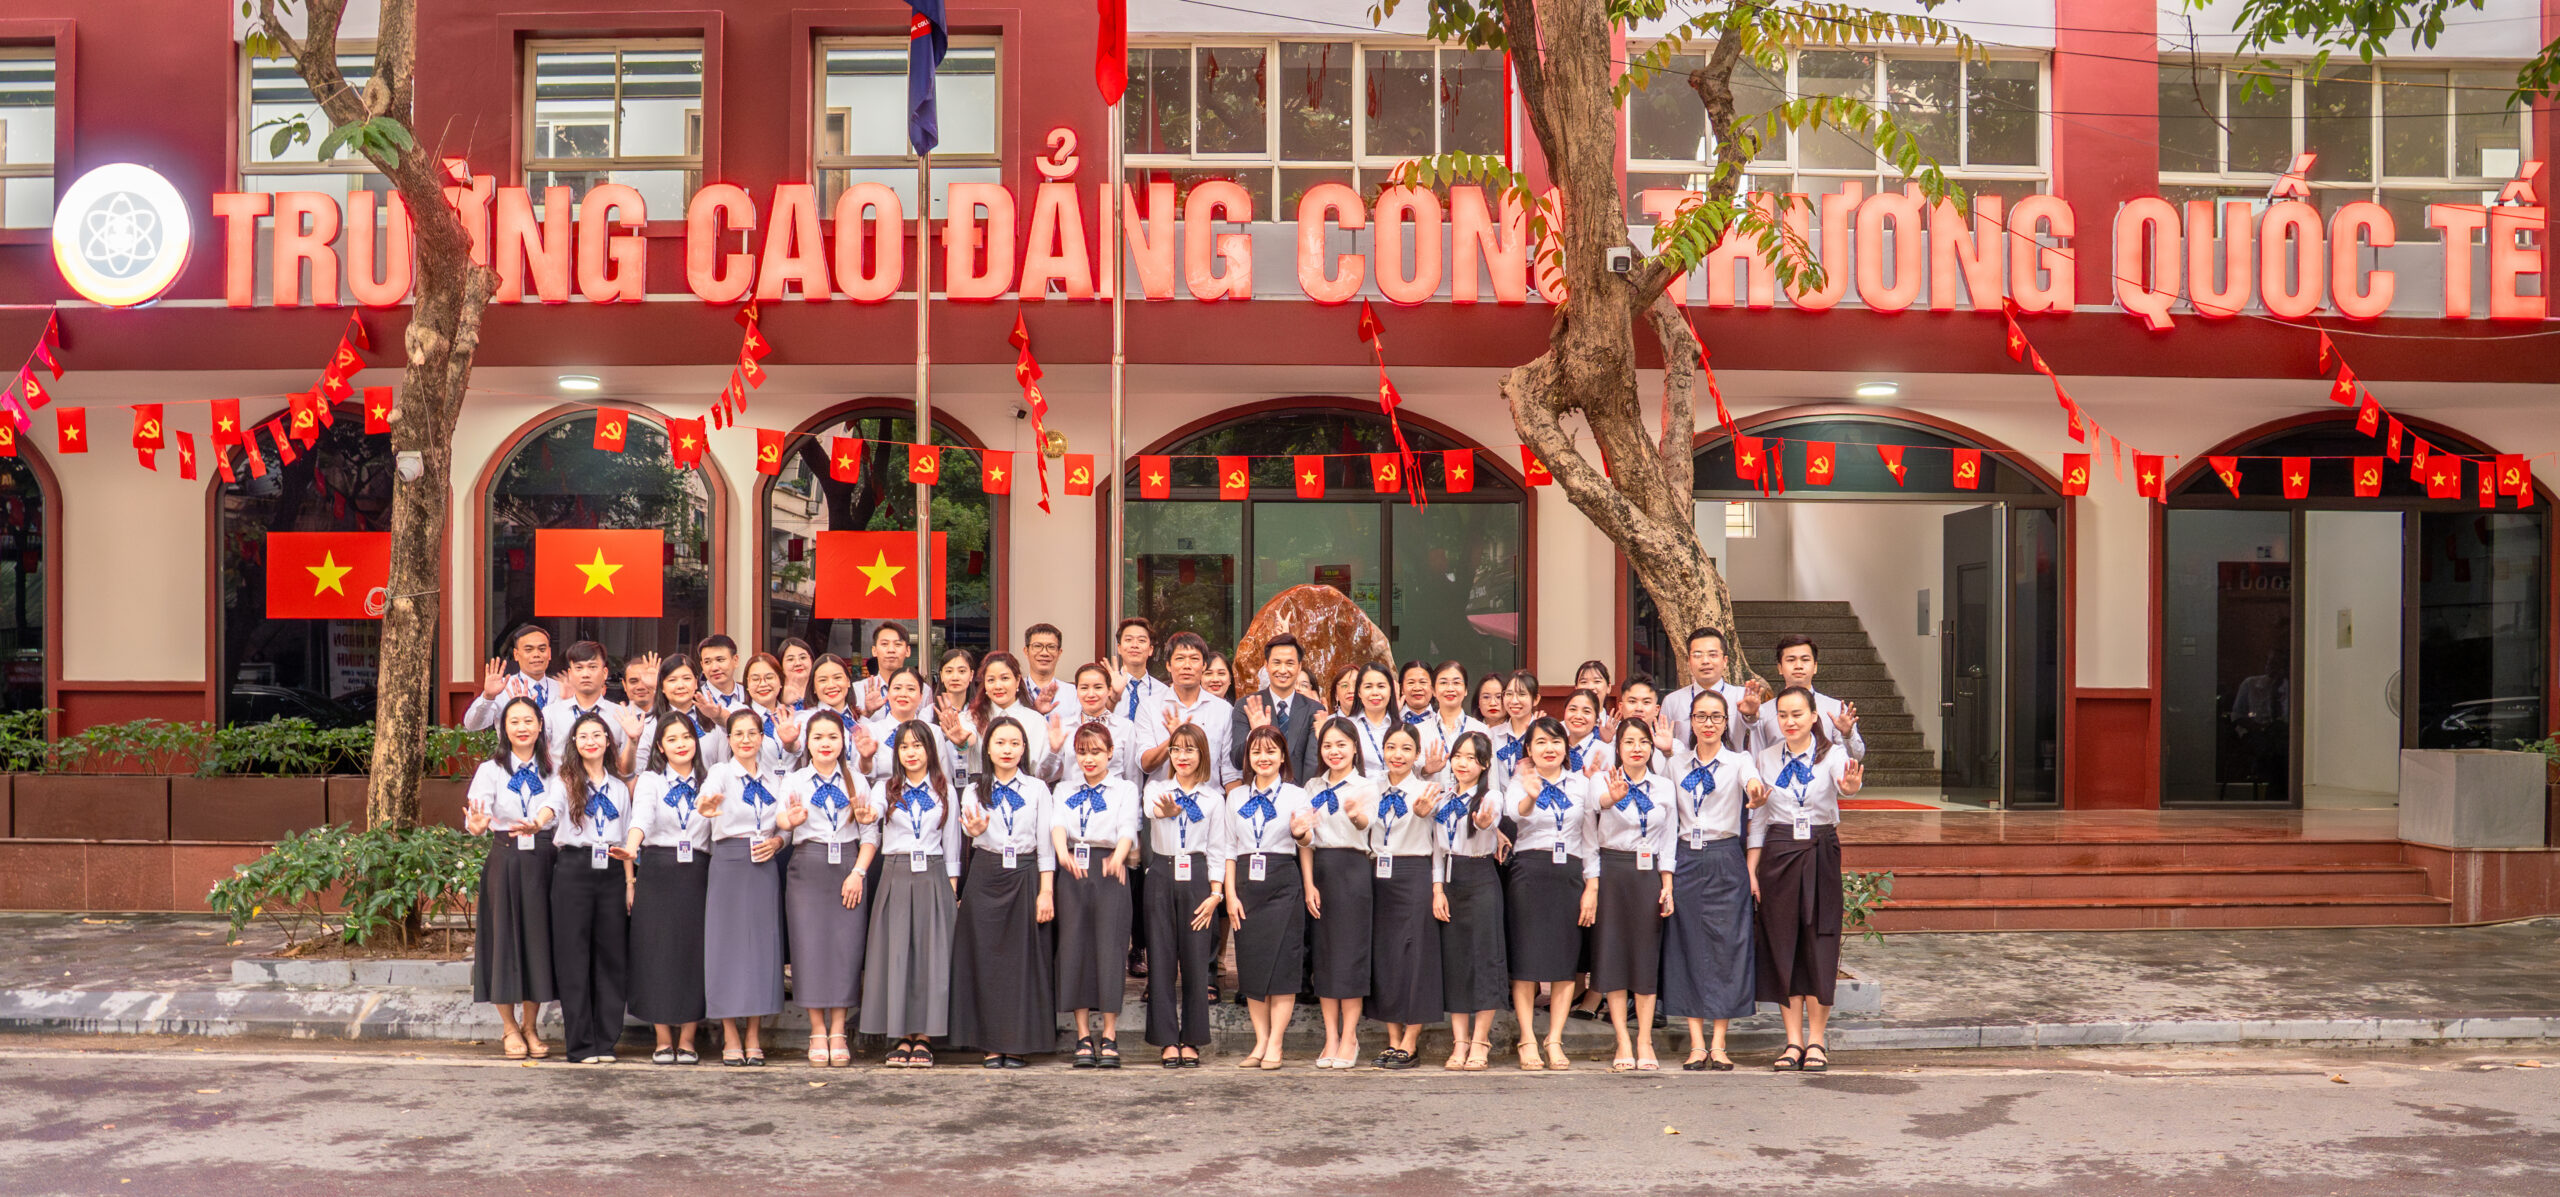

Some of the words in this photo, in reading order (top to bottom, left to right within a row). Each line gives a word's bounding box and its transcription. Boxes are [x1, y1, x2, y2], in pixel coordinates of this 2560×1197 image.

[687, 182, 904, 302] CAO
[942, 128, 1253, 302] ĐẲNG
[2115, 154, 2395, 331] QUỐC
[2428, 161, 2547, 320] TẾ
